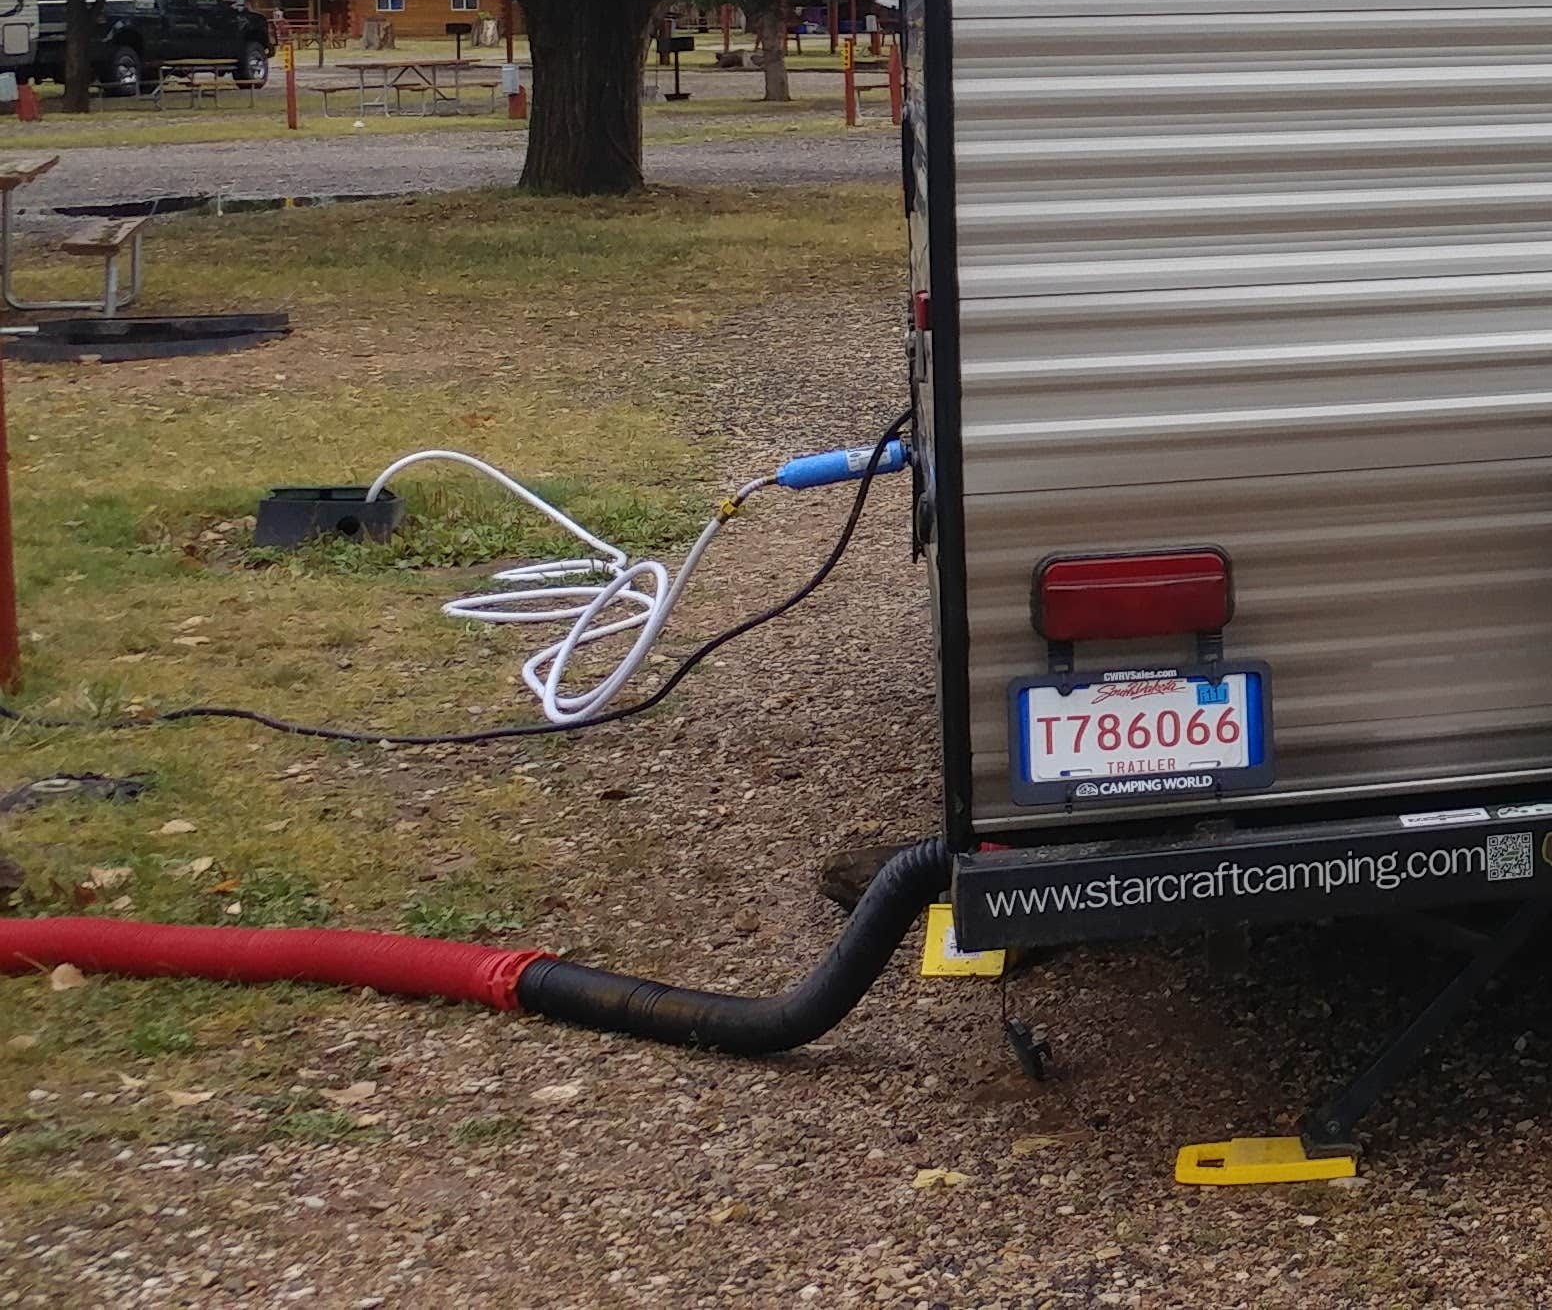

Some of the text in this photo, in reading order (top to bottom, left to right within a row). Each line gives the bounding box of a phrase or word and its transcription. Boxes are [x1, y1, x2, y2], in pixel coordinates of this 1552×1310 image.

[1103, 669, 1178, 682] CWRVSales.com
[1036, 706, 1241, 756] T786066
[1106, 757, 1177, 775] TRAILER
[1099, 774, 1213, 795] CAMPING WORLD
[985, 843, 1487, 919] www.starcraftcamping.com
